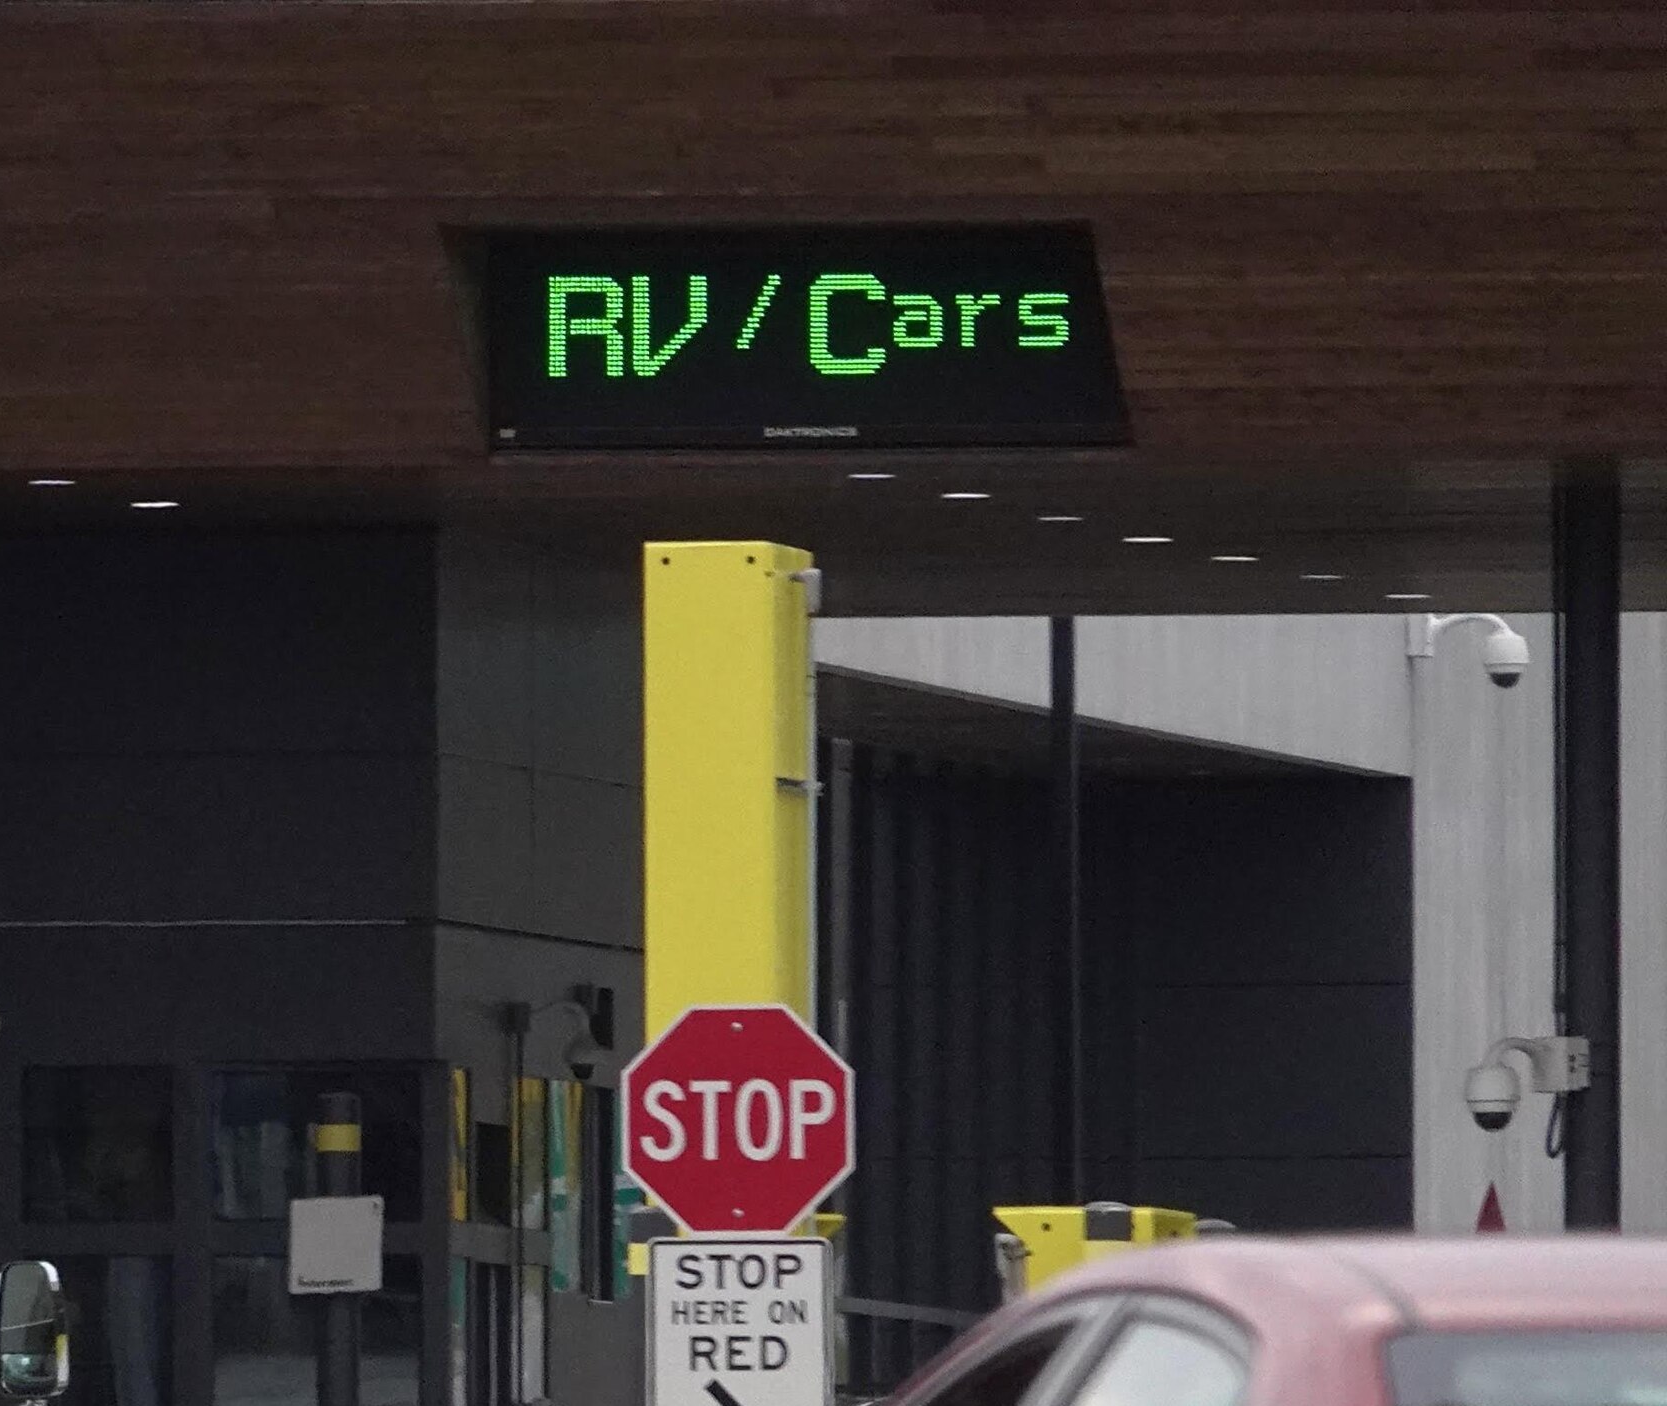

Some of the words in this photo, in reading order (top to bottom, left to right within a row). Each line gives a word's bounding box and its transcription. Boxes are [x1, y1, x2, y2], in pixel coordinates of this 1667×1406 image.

[640, 1078, 837, 1162] STOP
[676, 1254, 802, 1290] STOP
[671, 1301, 748, 1325] HERE
[767, 1301, 808, 1325] ON
[689, 1336, 788, 1372] RED
